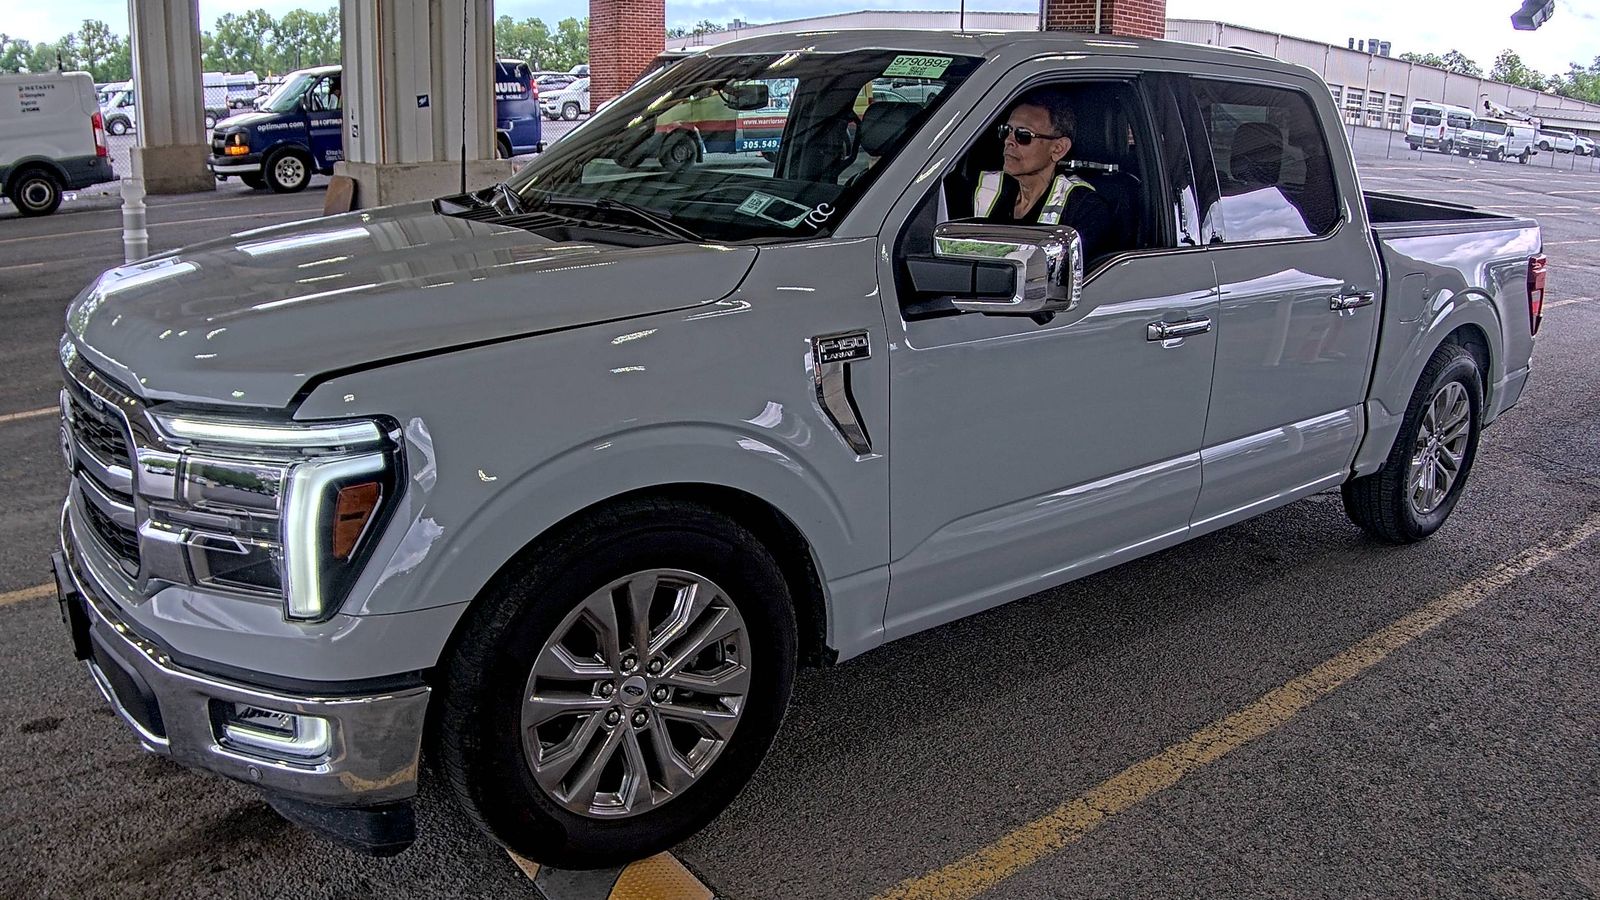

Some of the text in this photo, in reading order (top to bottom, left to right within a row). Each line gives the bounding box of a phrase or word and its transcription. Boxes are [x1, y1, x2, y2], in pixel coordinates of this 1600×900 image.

[893, 57, 951, 68] 9790892
[257, 121, 304, 132] optimumcom
[820, 336, 867, 353] F-150
[824, 350, 855, 360] LARIAT
